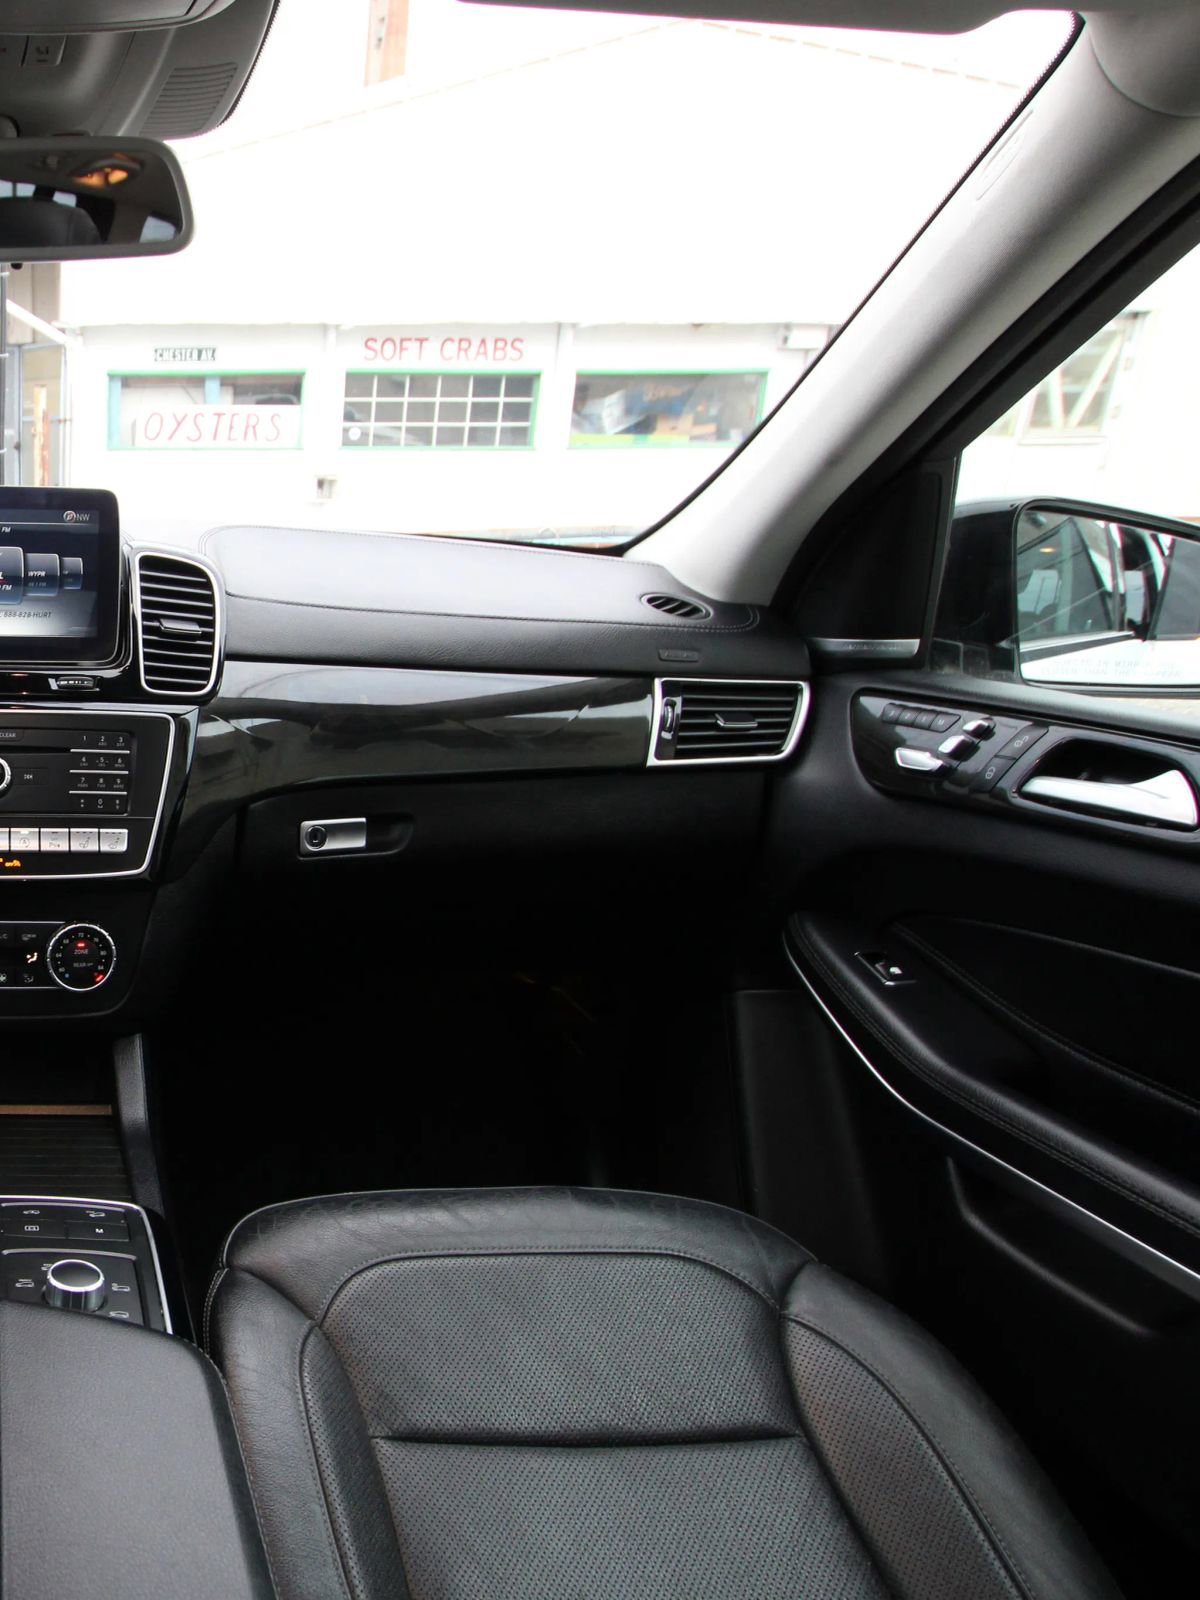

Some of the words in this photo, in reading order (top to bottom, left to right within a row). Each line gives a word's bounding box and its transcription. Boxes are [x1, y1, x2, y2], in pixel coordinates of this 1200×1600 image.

[363, 336, 430, 361] SOFT
[439, 336, 525, 362] CRABS
[144, 412, 282, 442] OYSTERS
[76, 513, 90, 521] NW
